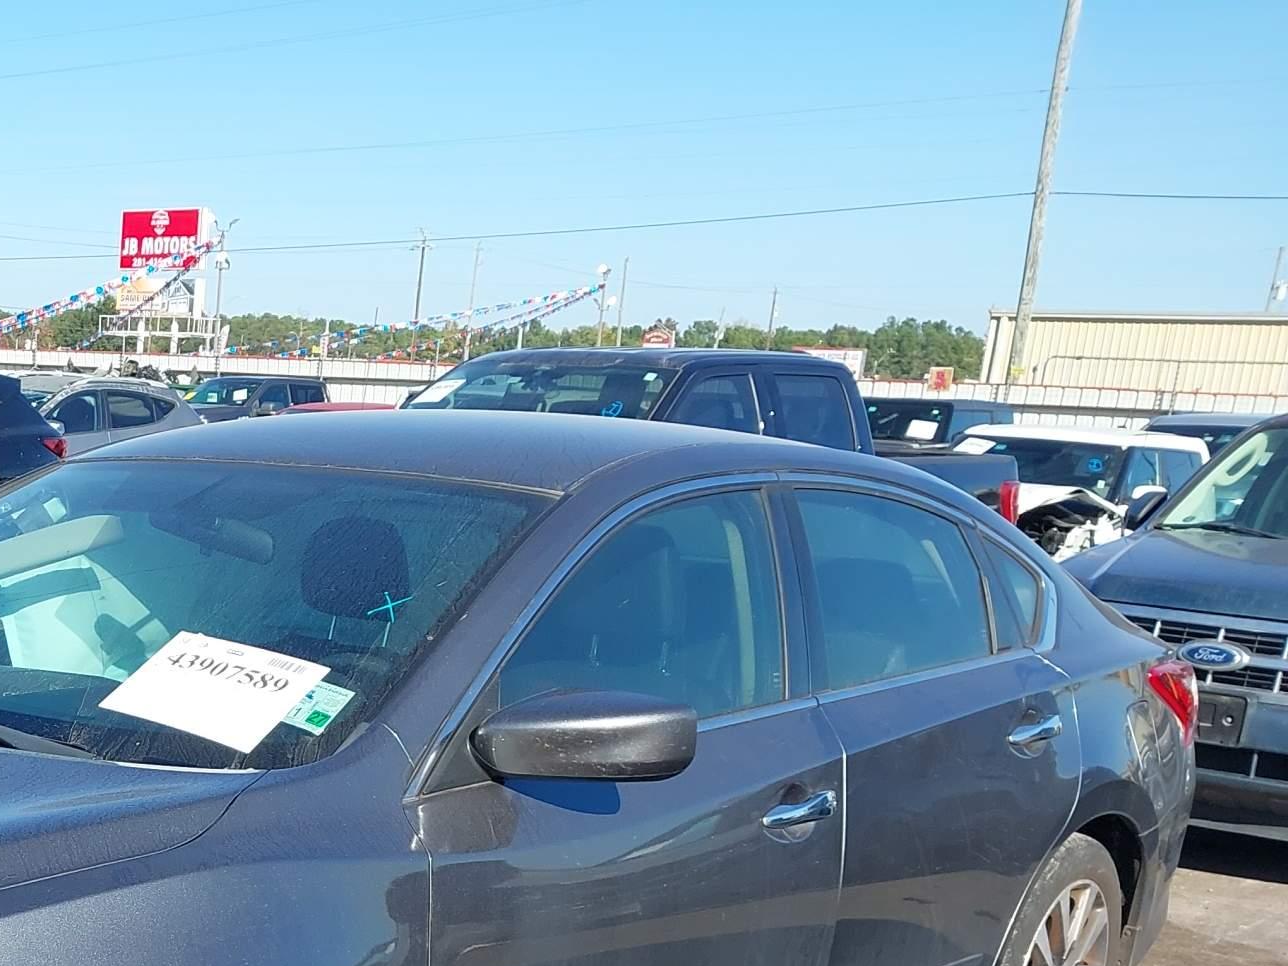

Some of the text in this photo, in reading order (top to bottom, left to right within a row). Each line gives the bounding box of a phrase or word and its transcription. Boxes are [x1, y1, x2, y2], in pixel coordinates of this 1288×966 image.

[122, 235, 198, 256] JB MOTORS
[1194, 647, 1227, 662] Ford
[167, 652, 290, 693] 43907589
[309, 711, 329, 727] 27
